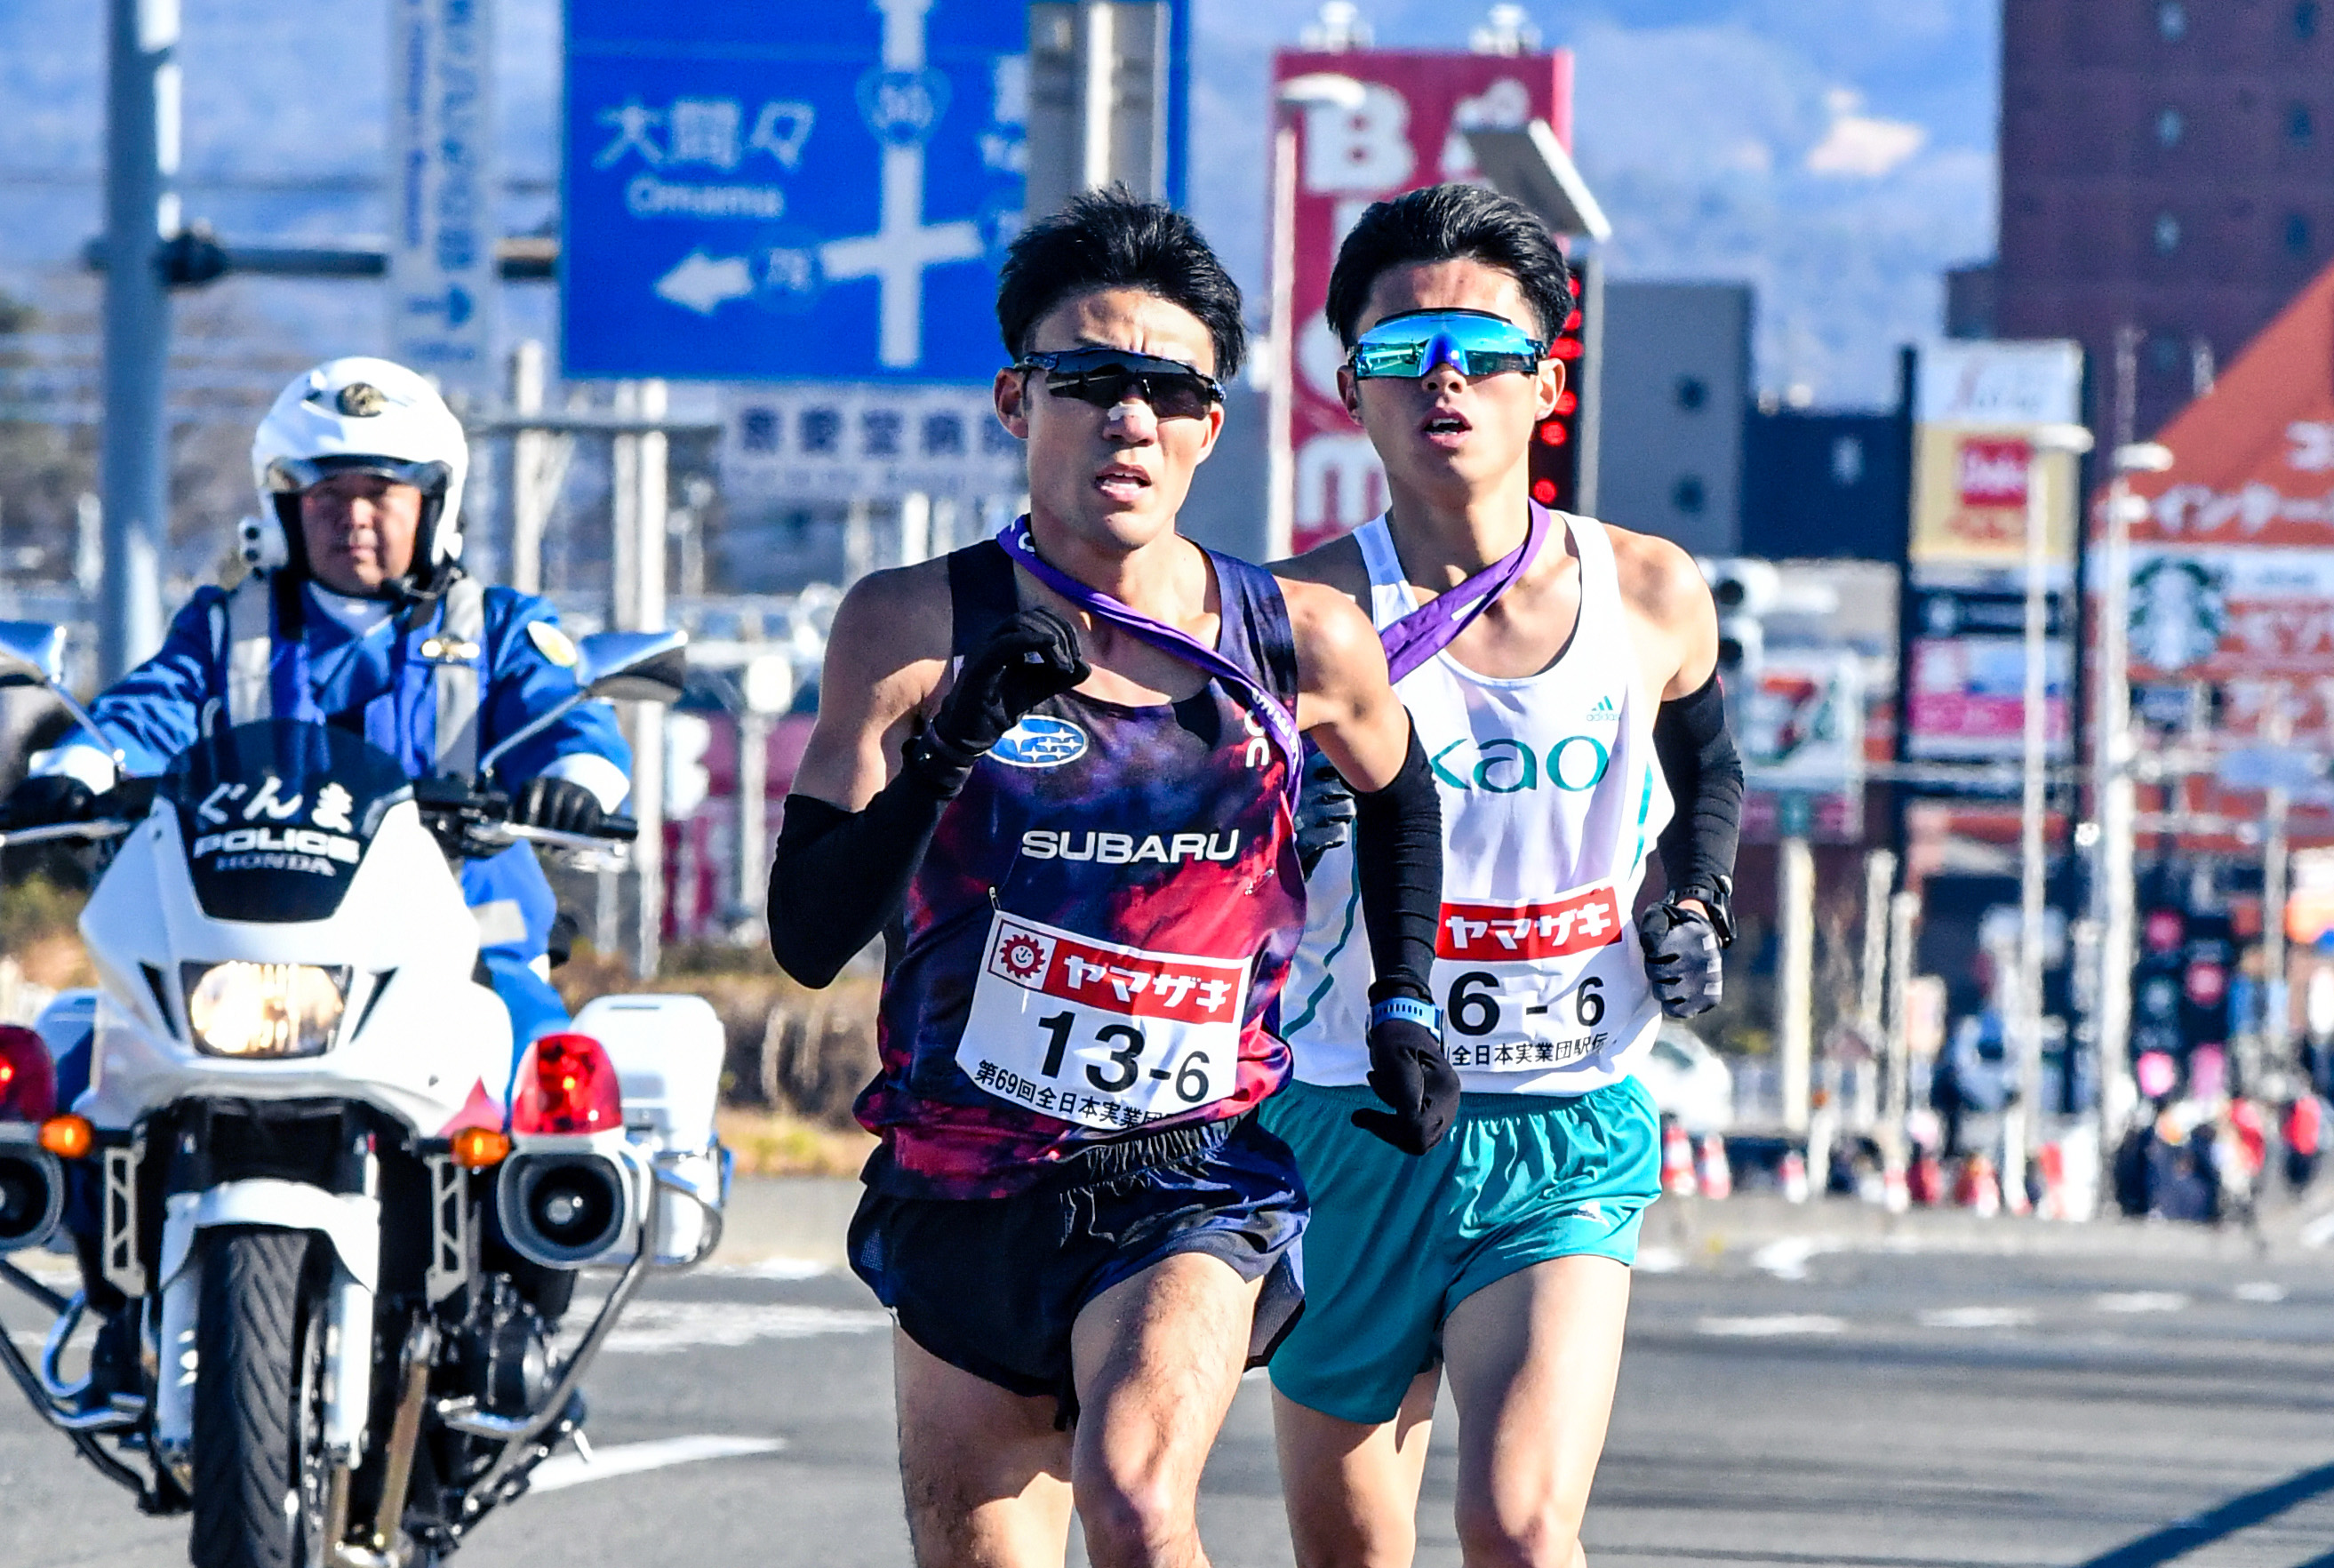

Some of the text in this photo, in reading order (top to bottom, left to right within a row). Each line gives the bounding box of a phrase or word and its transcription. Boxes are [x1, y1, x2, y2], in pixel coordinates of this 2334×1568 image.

[590, 96, 816, 169] 大間々
[626, 176, 784, 219] Omama
[198, 776, 353, 833] ぐんま
[193, 828, 360, 864] POLICE
[215, 853, 337, 876] HONDA
[1021, 828, 1240, 864] SUBARU
[1445, 902, 1611, 950] ヤマザキ
[1064, 954, 1232, 1013] ヤマザキ
[1446, 1032, 1608, 1067] 全日本実業団駅伝
[974, 1060, 1173, 1129] 第69回全日本実業団
